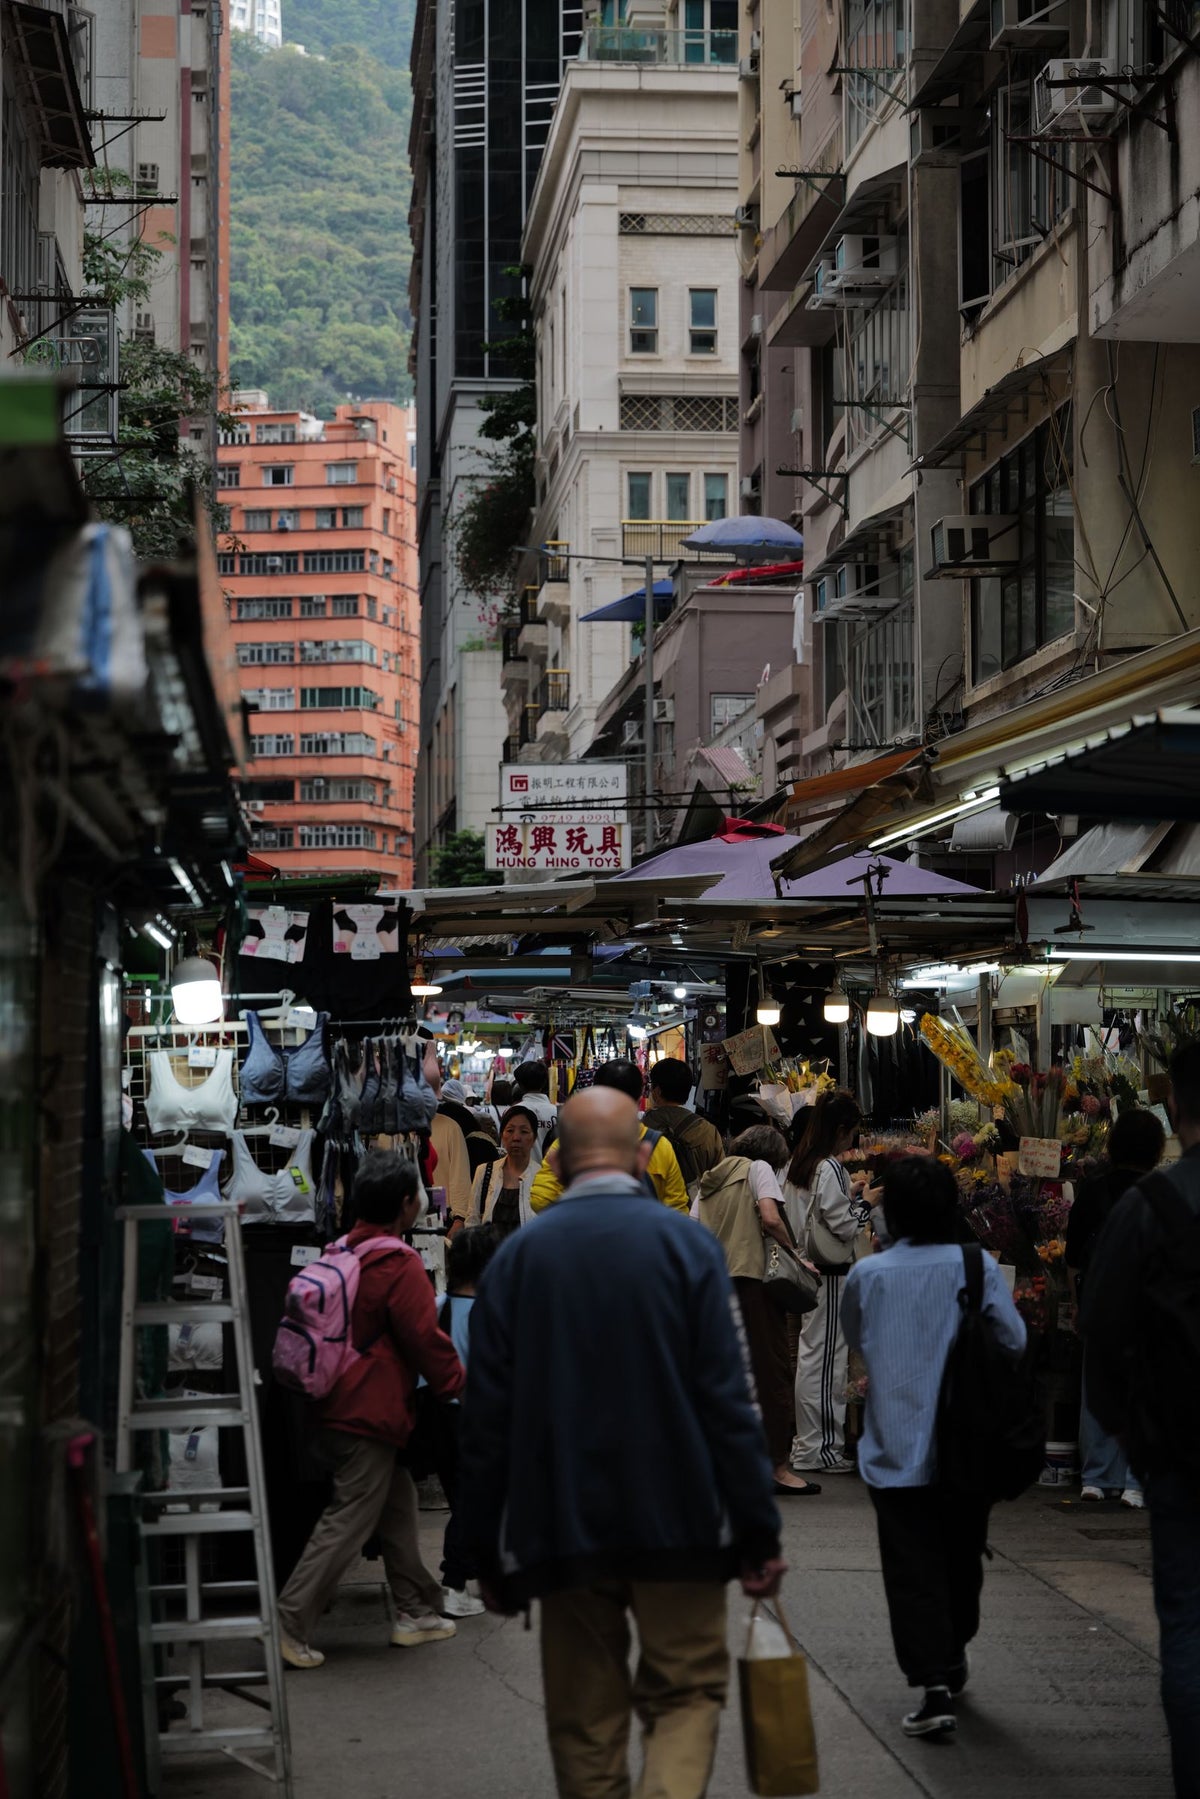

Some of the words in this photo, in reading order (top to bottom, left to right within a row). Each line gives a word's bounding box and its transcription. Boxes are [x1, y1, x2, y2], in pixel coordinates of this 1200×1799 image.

[531, 775, 620, 789] 振明工程有限公司
[496, 824, 622, 856] 鴻興玩具
[496, 857, 536, 868] HUNG
[545, 857, 580, 868] HING
[587, 857, 621, 868] TOYS
